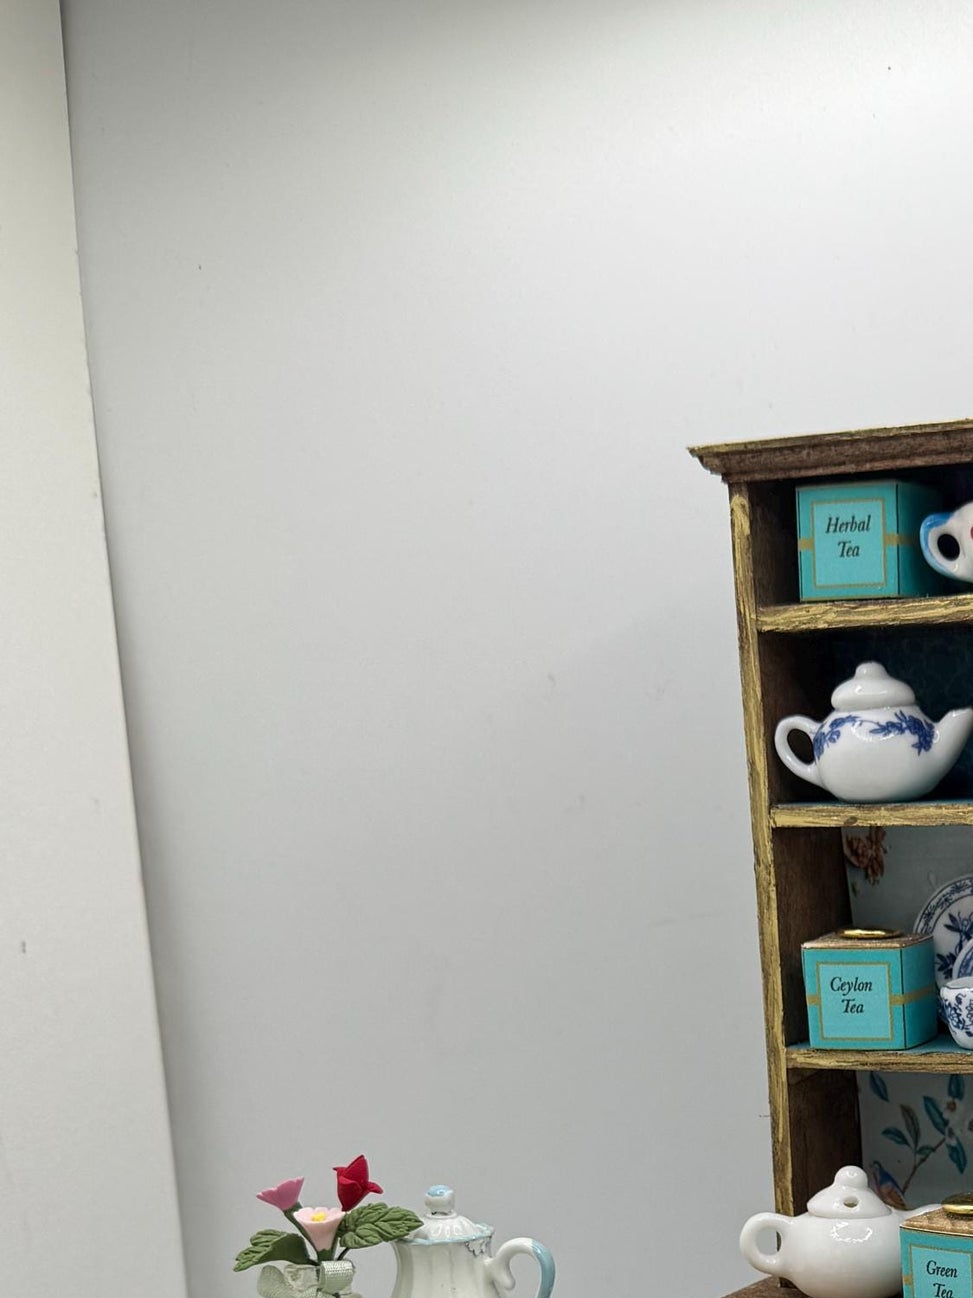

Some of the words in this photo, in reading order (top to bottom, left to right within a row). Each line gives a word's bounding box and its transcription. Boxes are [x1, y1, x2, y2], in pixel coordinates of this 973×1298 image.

[825, 514, 871, 535] Herbal
[837, 540, 861, 558] Tea
[829, 975, 874, 997] Ceylon
[841, 997, 865, 1015] Tea
[926, 1259, 958, 1279] Green
